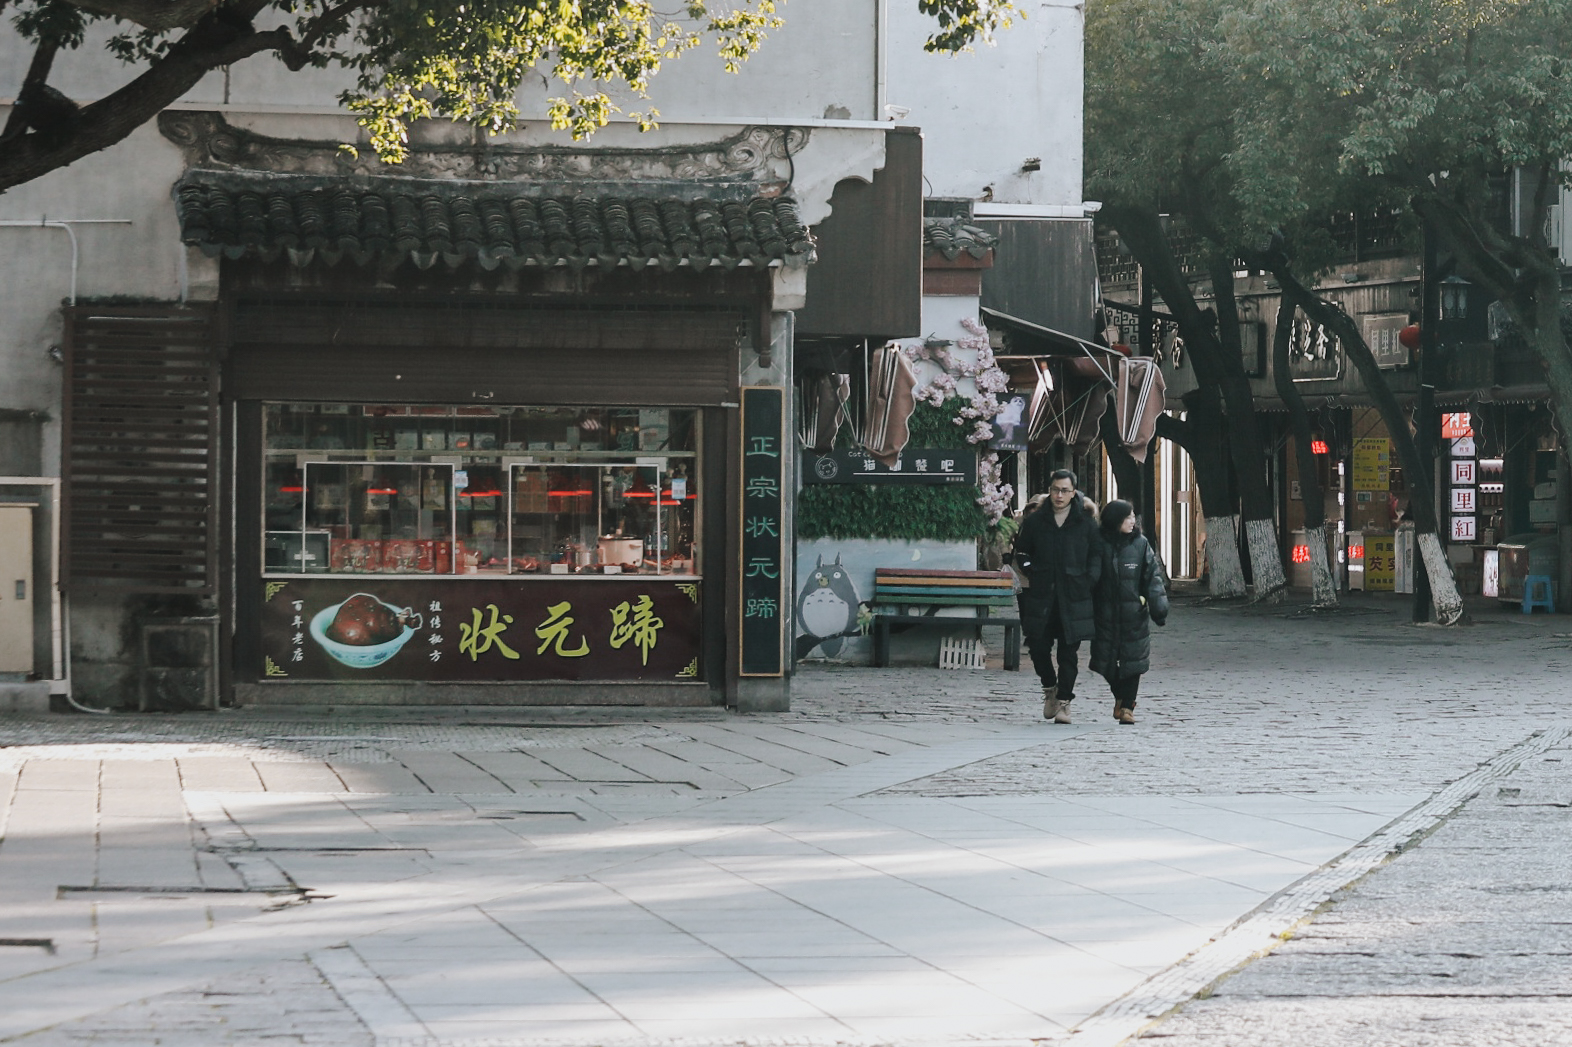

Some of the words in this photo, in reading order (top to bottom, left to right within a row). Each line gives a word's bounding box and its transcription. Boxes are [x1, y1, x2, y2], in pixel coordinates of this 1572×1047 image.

[745, 436, 779, 619] 正宗状元蹄
[291, 600, 304, 663] 百年老店
[430, 600, 443, 663] 祖传秘方
[458, 594, 665, 666] 状元蹄
